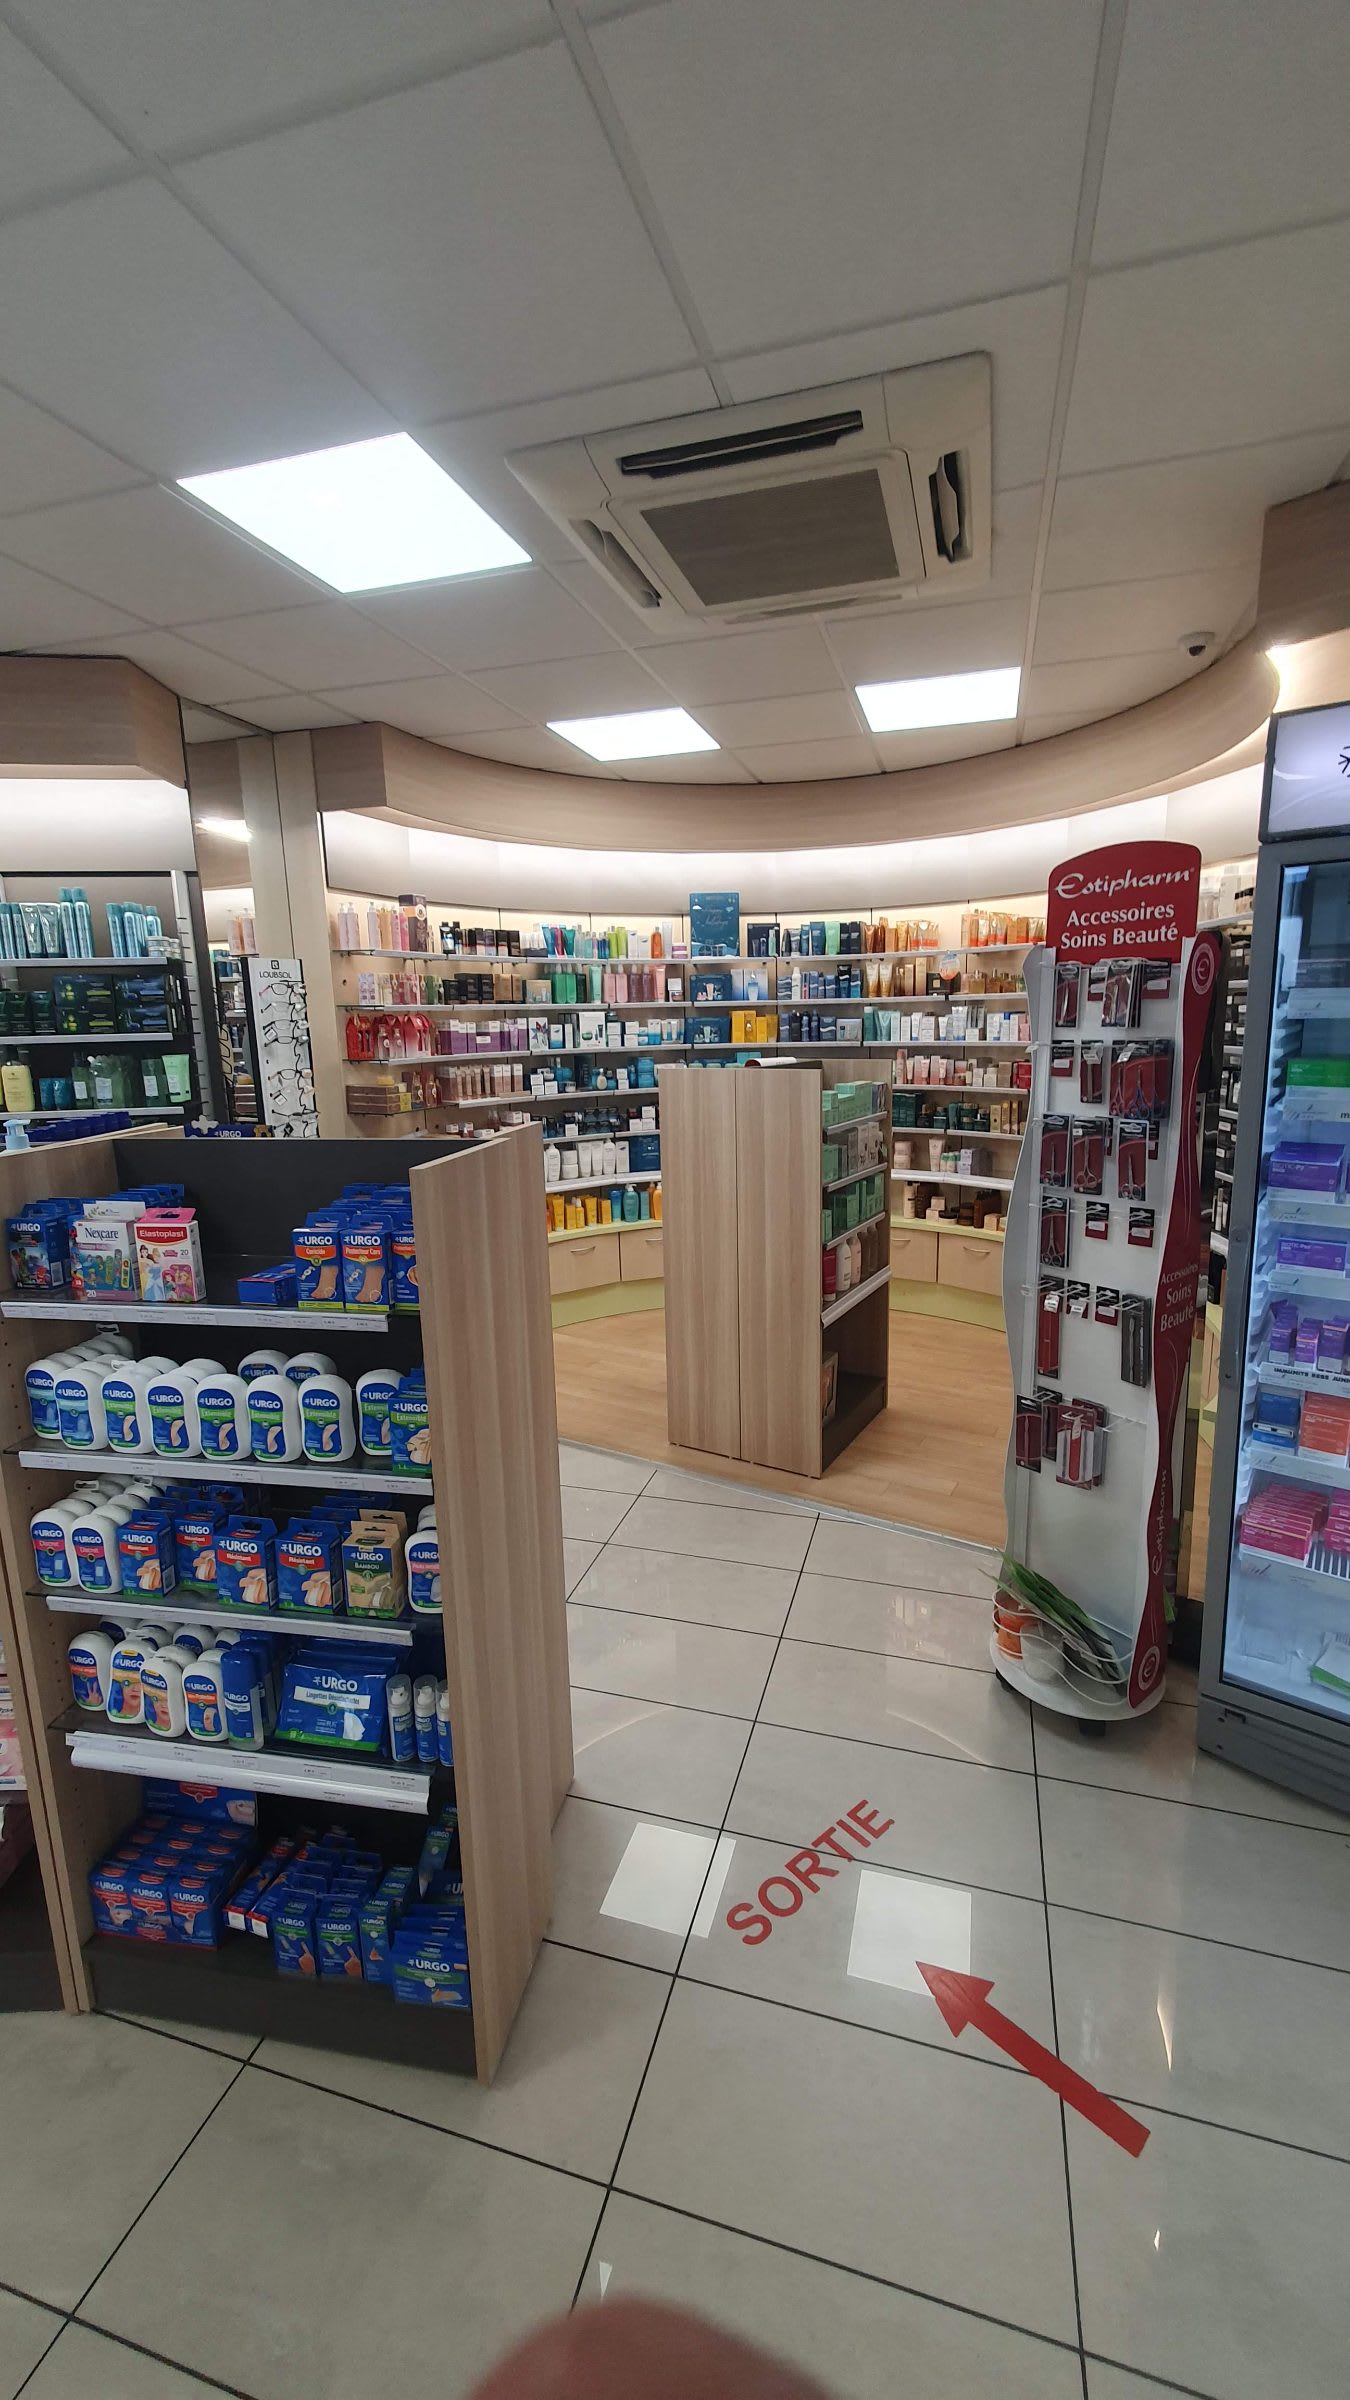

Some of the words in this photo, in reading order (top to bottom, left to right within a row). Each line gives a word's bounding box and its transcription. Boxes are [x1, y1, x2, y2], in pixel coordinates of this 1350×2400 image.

[1055, 868, 1190, 899] Estipharm
[1066, 901, 1175, 928] Accessoires
[1061, 929, 1107, 950] Soins
[1113, 922, 1178, 945] Beauté
[259, 971, 292, 979] LOUBSOL
[218, 1130, 241, 1138] URGO
[17, 1223, 41, 1232] URGO
[84, 1227, 119, 1241] Nexcare
[139, 1229, 184, 1238] Elastoplast
[304, 1236, 332, 1245] URGO
[351, 1236, 381, 1245] URGO
[1160, 1263, 1198, 1285] Accessoires
[86, 1290, 97, 1298] 20
[1166, 1284, 1192, 1308] Soins
[1160, 1302, 1194, 1332] Beauté
[250, 1369, 276, 1377] URGO
[33, 1378, 54, 1387] URGO
[62, 1388, 86, 1397] URGO
[109, 1389, 134, 1398] URGO
[155, 1394, 182, 1403] URGO
[205, 1398, 232, 1406] URGO
[309, 1398, 338, 1407] URGO
[254, 1400, 281, 1408] URGO
[400, 1403, 428, 1412] URGO
[185, 1525, 210, 1535] URGO
[79, 1536, 102, 1544] URGO
[128, 1535, 154, 1544] URGO
[226, 1541, 258, 1554] URGO
[288, 1544, 322, 1556] URGO
[357, 1552, 384, 1561] URGO
[418, 1551, 438, 1559] URG
[73, 1656, 95, 1665] URGO
[120, 1660, 143, 1668] URGO
[147, 1676, 166, 1688] URGO
[321, 1675, 358, 1692] URGO
[190, 1683, 214, 1691] URGO
[227, 1692, 249, 1702] URGO
[726, 1799, 895, 1946] SORTIE
[100, 1882, 124, 1892] URGO
[138, 1888, 163, 1899] URGO
[178, 1893, 205, 1903] URGO
[282, 1917, 305, 1927] URGO
[366, 1918, 384, 1926] URGO
[327, 1923, 351, 1931] URGO
[415, 1959, 450, 1972] URGO
